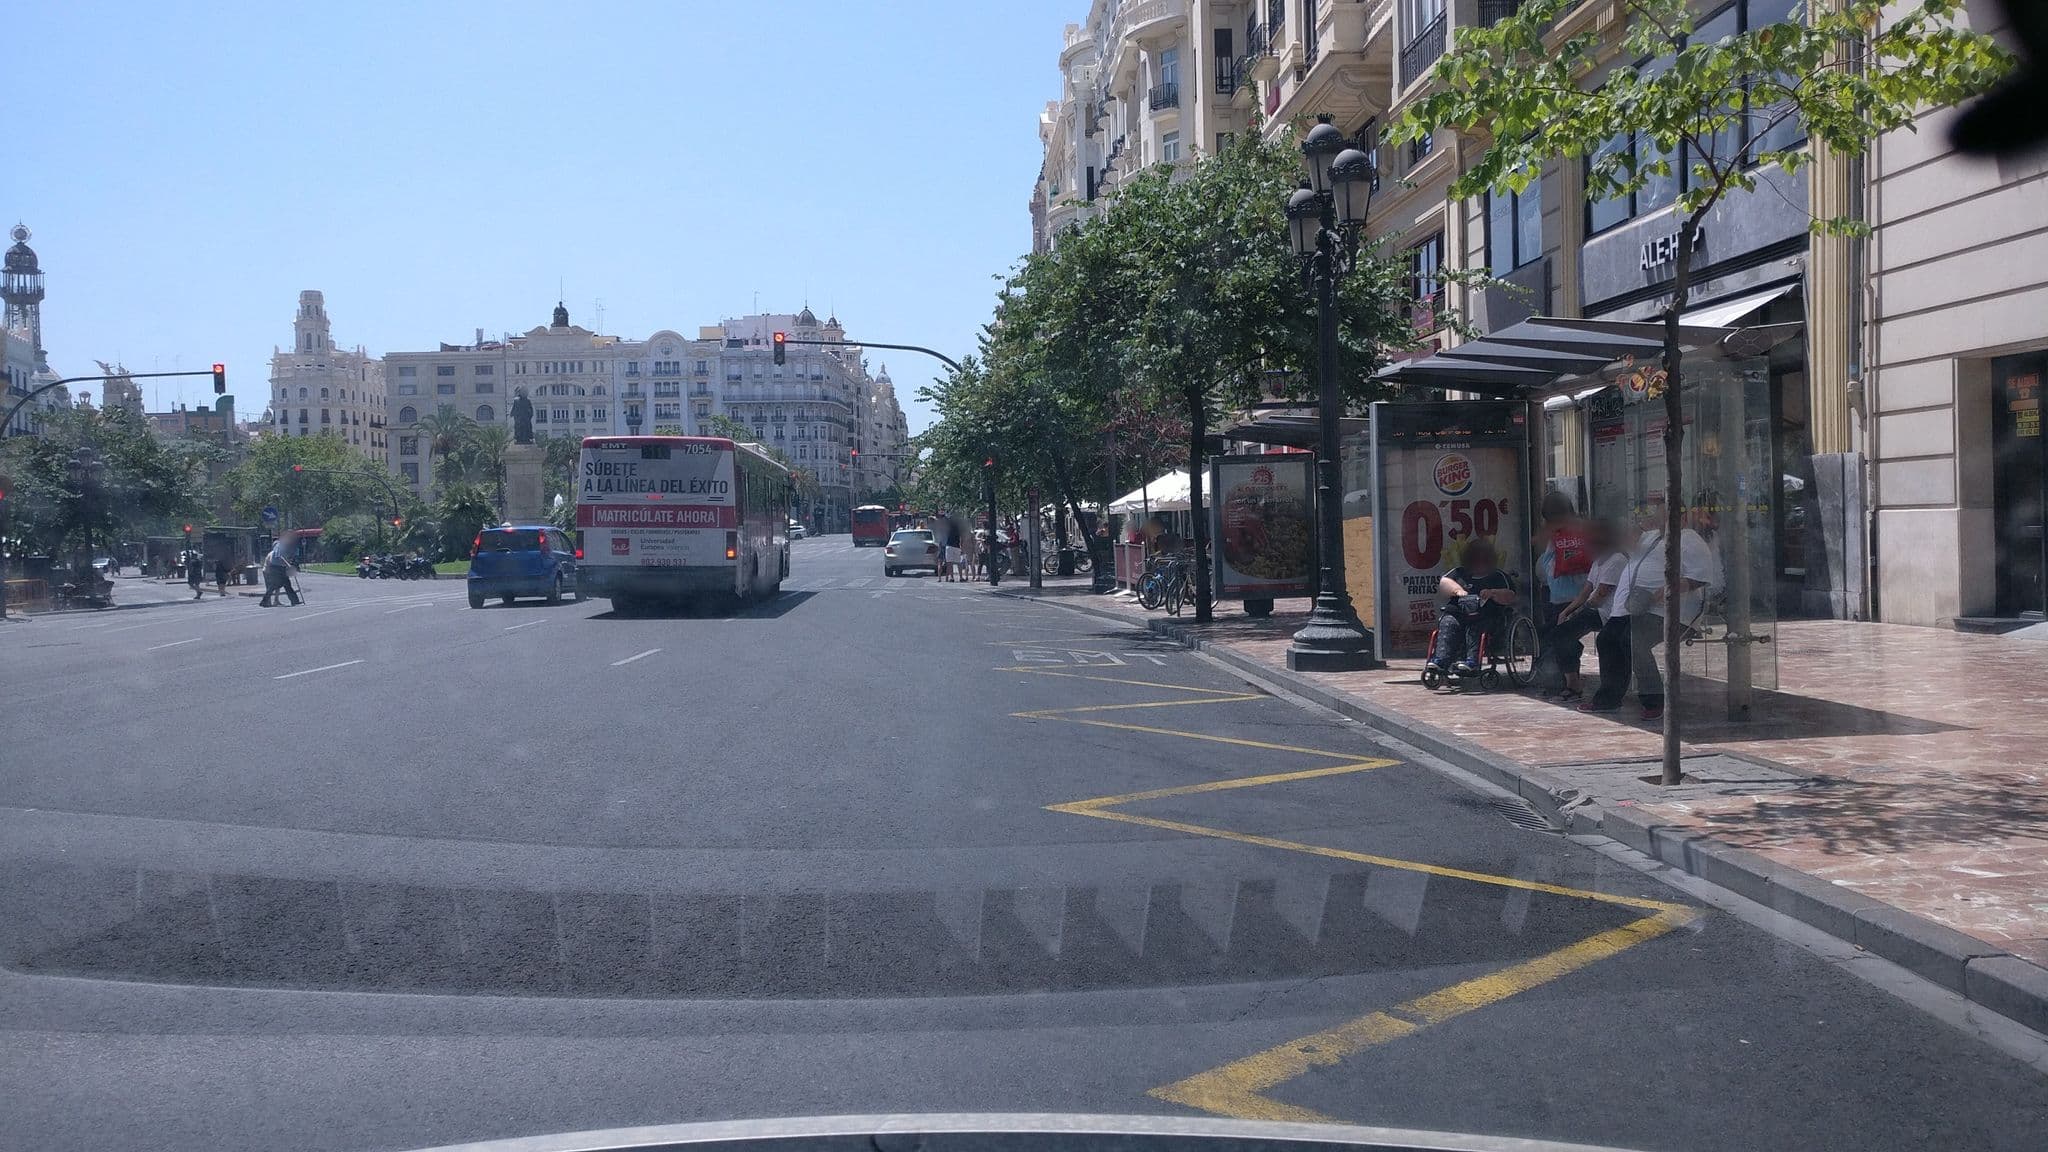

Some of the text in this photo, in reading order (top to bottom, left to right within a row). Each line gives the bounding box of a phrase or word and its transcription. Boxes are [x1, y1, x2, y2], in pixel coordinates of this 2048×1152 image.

[1640, 223, 1699, 270] ALE-HP
[685, 444, 712, 455] 7054
[585, 459, 638, 476] SÚBETE
[1437, 461, 1469, 477] BURGER
[584, 476, 729, 494] A LA LÍNEA DEL ÉXITO
[1439, 469, 1471, 487] KING
[1403, 575, 1441, 586] PATATAS
[1407, 585, 1438, 595] FRITAS
[1411, 609, 1437, 623] DÍAS
[1012, 650, 1167, 666] EMT
